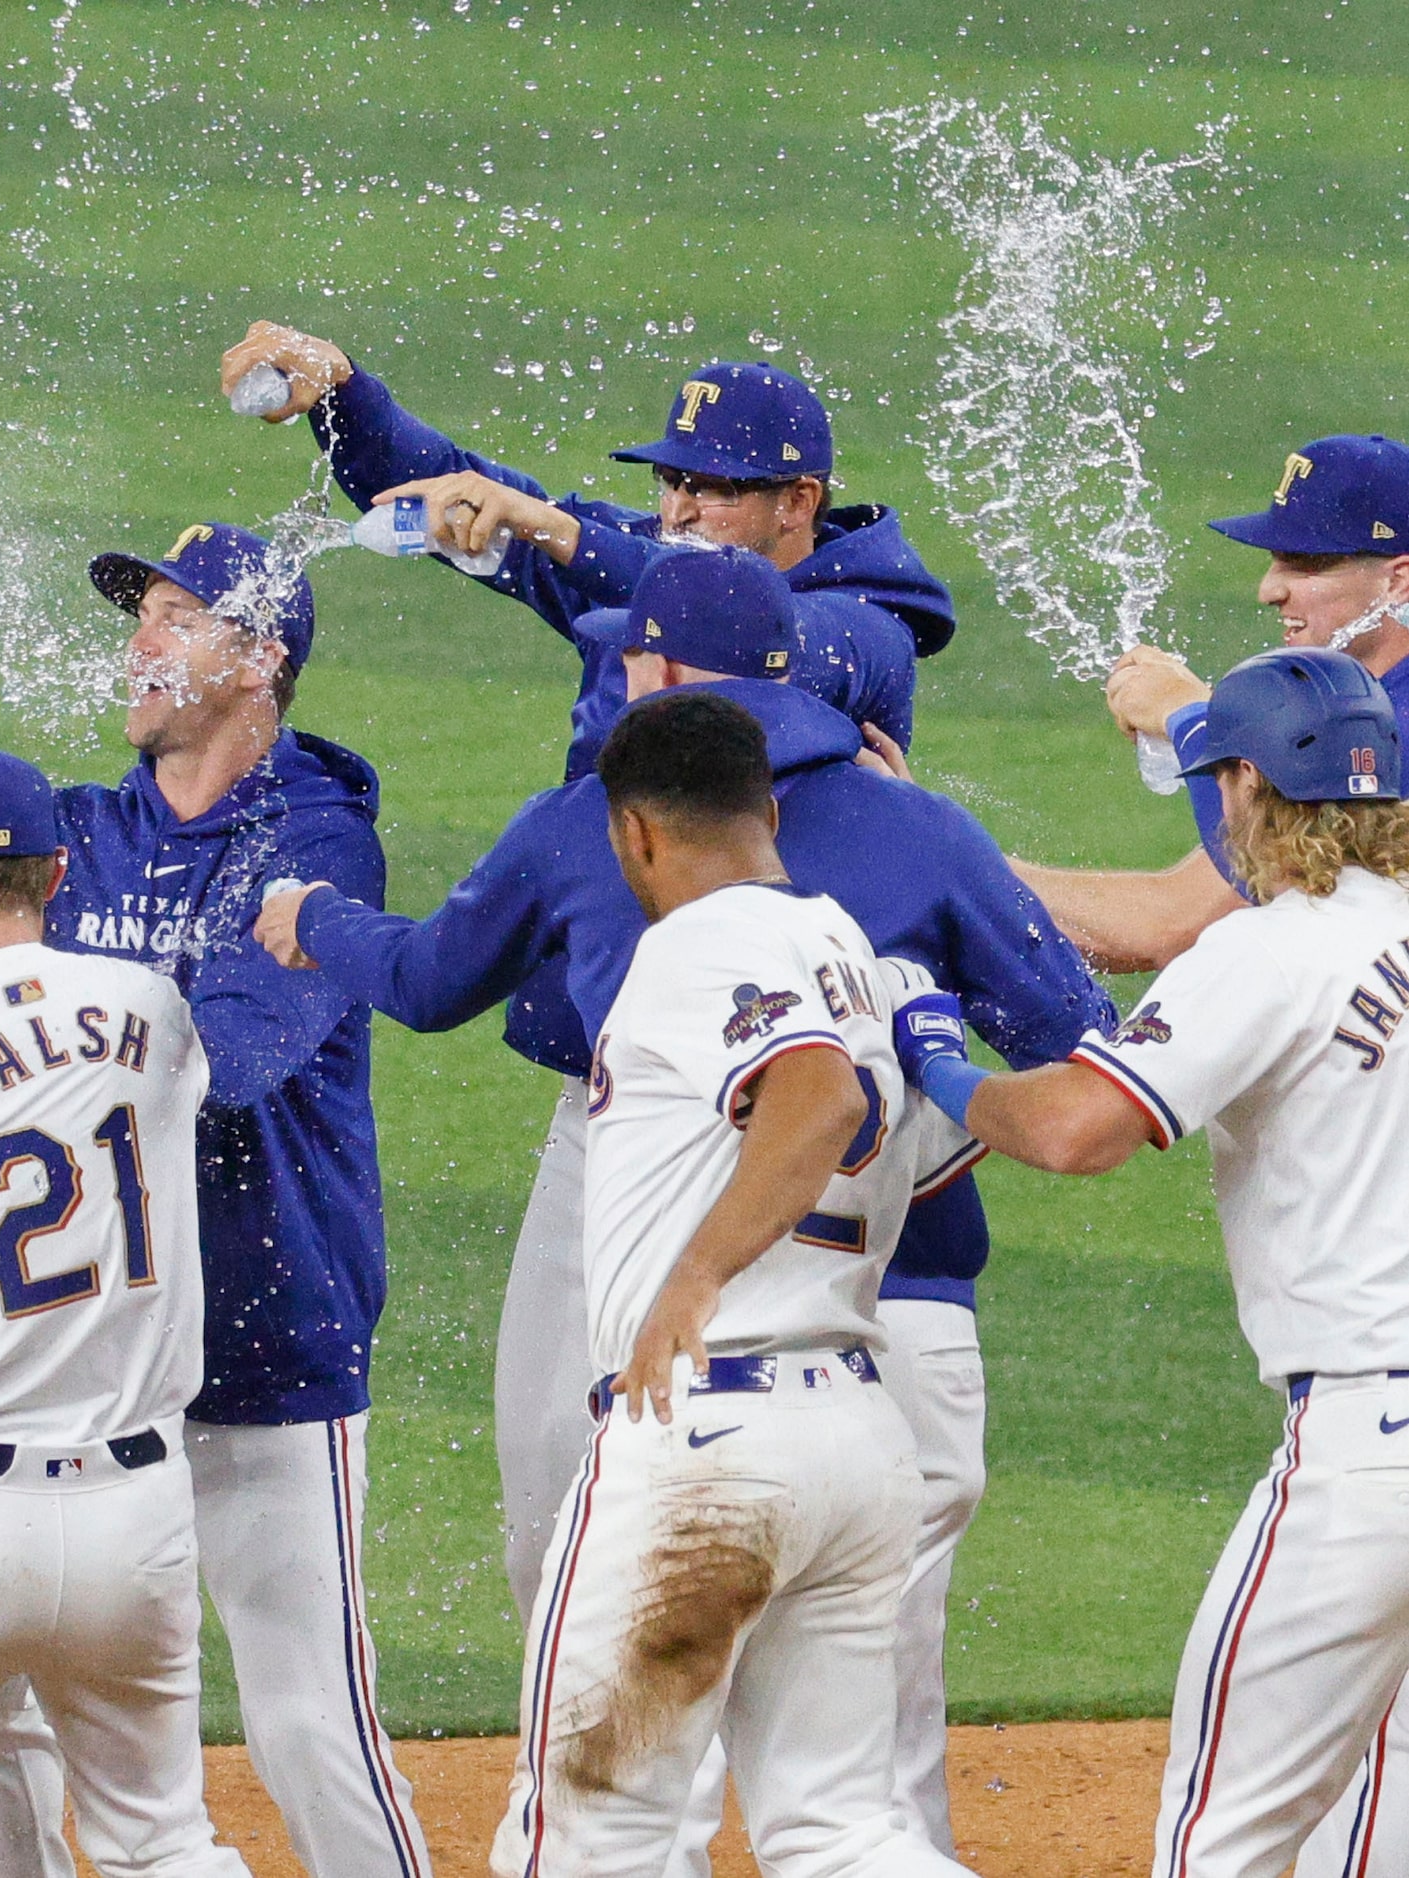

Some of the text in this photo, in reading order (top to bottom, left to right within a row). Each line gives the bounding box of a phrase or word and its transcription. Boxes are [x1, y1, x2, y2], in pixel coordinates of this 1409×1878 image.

[676, 380, 721, 433] T
[1350, 747, 1376, 774] 16
[1333, 936, 1409, 1074] JAN
